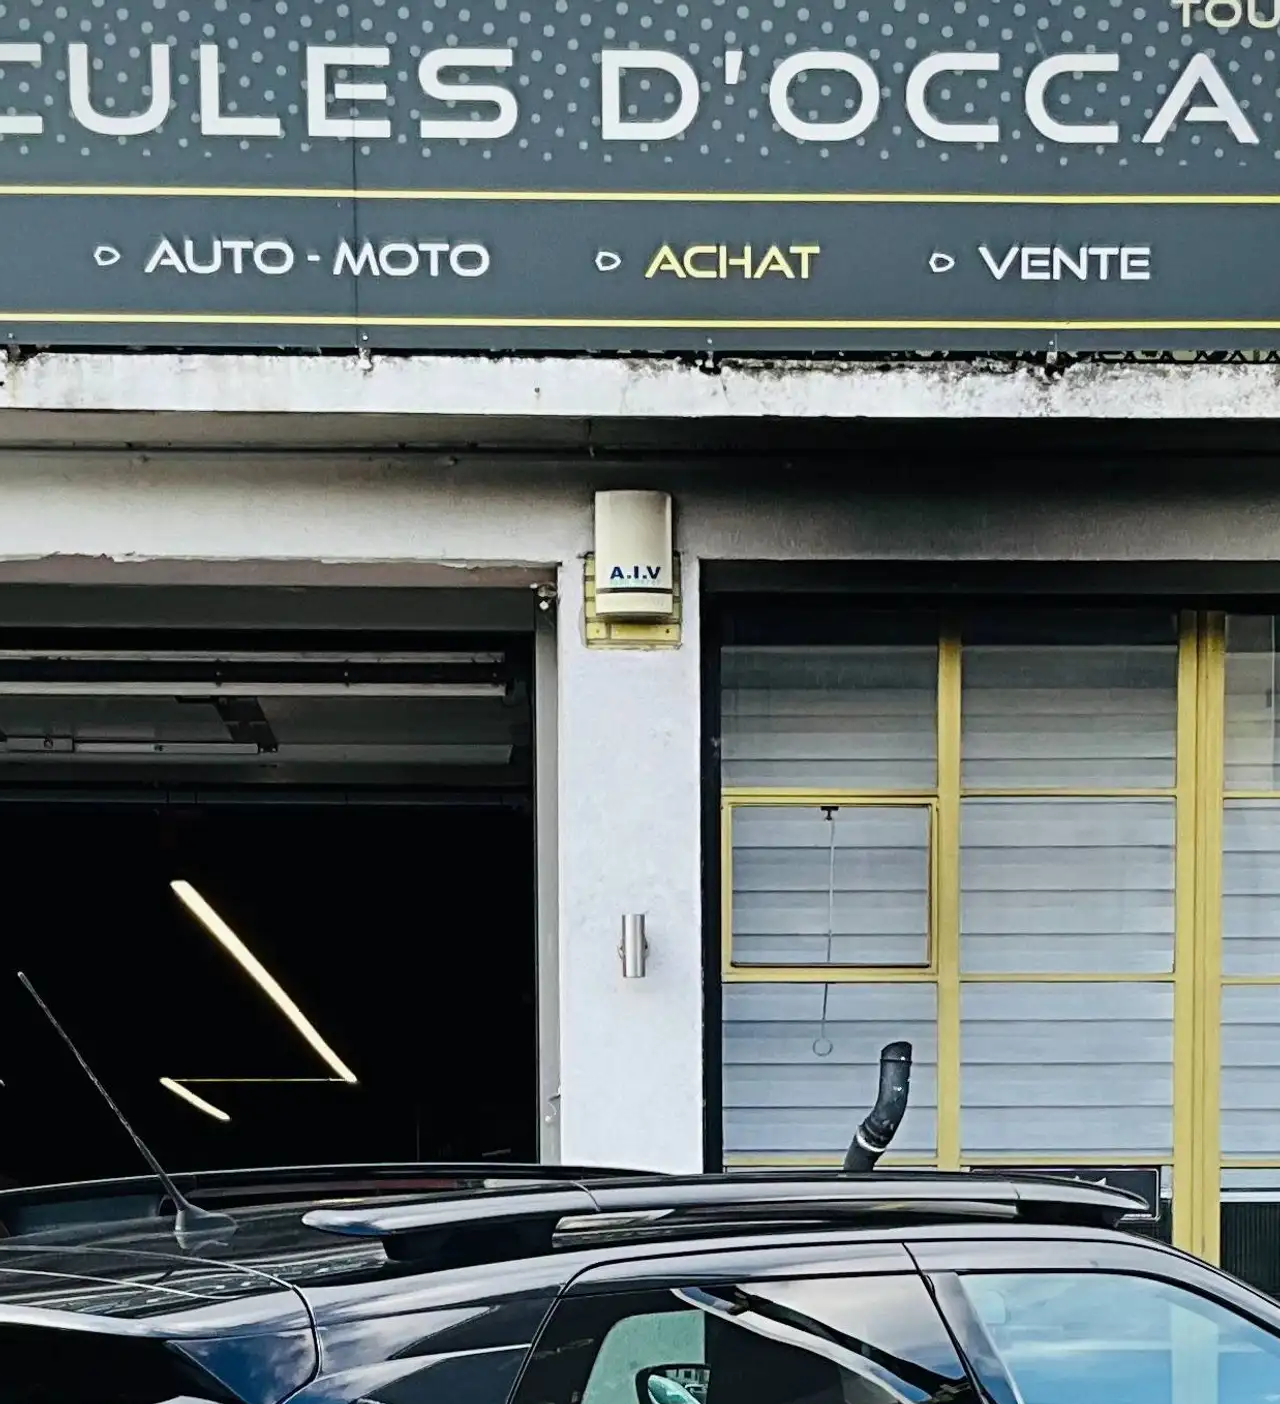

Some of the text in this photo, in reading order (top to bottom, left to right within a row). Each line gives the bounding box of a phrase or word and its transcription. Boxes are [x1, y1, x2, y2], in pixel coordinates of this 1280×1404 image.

[143, 239, 295, 276] AUTO
[332, 241, 491, 278] MOTO
[644, 243, 821, 280] ACHAT
[978, 246, 1153, 282] VENTE
